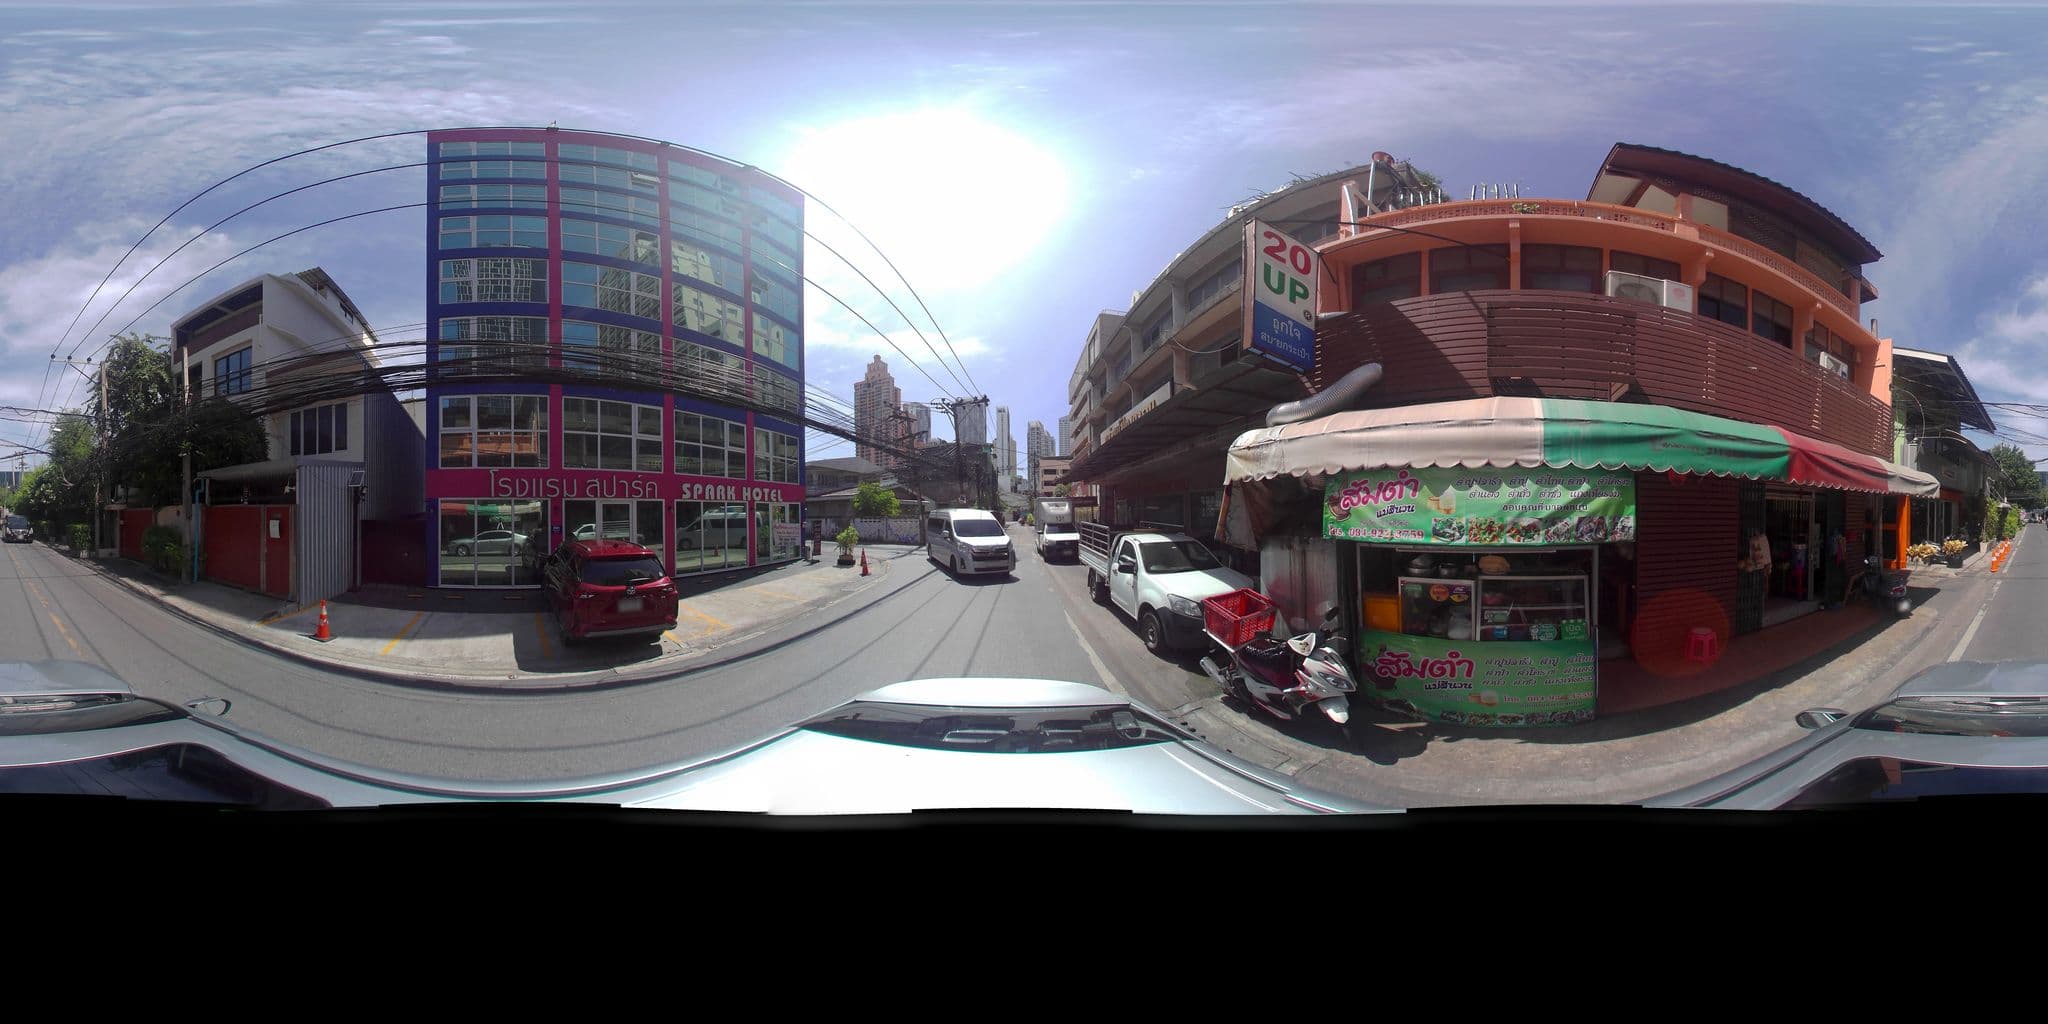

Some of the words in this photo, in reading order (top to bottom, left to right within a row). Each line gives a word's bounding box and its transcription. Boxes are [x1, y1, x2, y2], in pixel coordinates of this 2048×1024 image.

[1263, 230, 1312, 276] 20
[1263, 262, 1310, 304] UP
[1273, 317, 1301, 341] ถูกใจ
[489, 469, 577, 498] โรงแรม
[586, 474, 658, 498] สปาร์ค
[682, 483, 736, 501] SPARK
[742, 486, 784, 502] HOTEL
[1341, 469, 1419, 510] ส้มตำ
[1376, 650, 1475, 679] ส้มตำ
